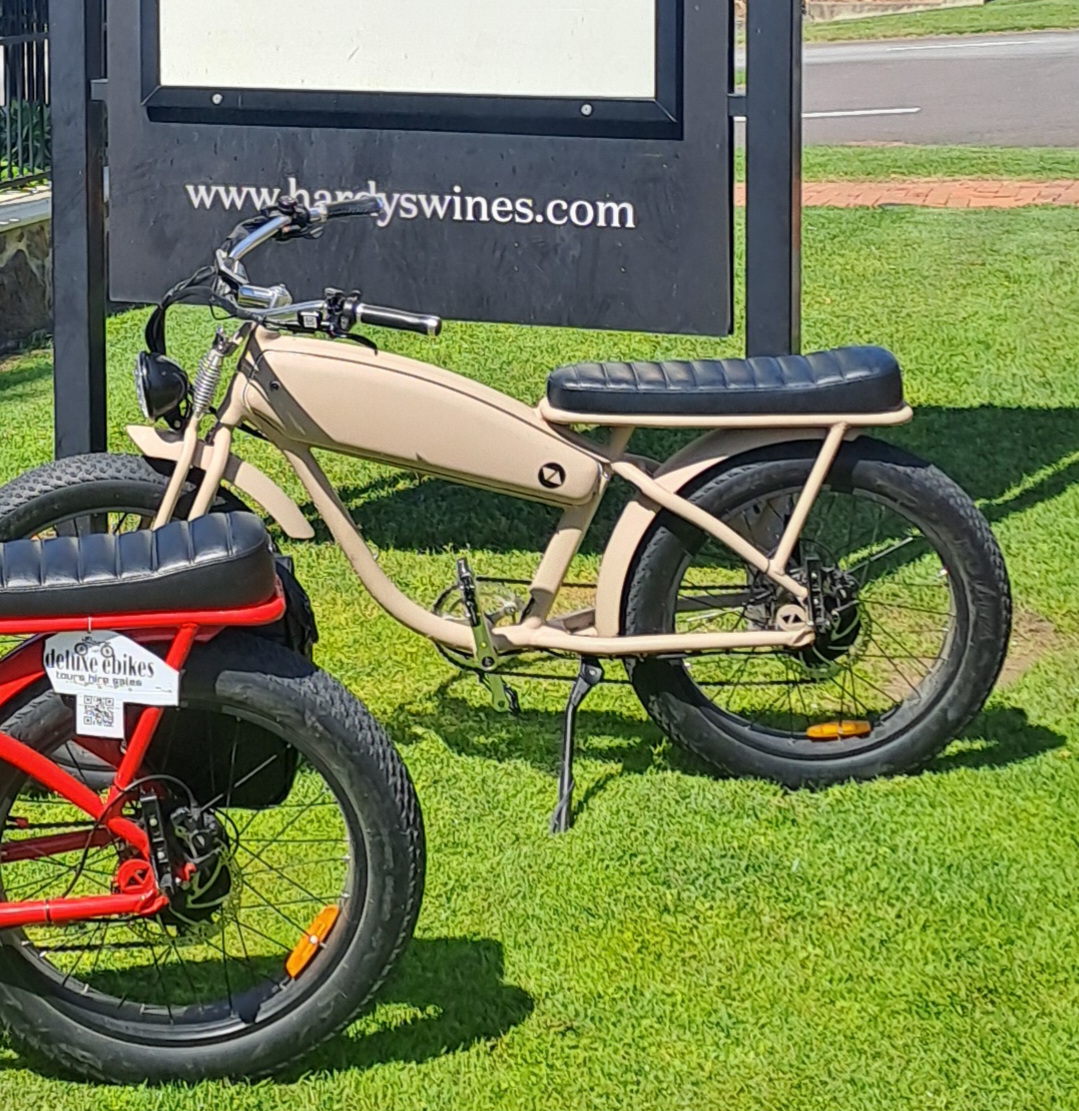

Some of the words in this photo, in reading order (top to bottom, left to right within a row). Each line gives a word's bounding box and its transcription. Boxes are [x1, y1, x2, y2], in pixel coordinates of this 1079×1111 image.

[185, 177, 636, 230] wwwhardyswines.com
[45, 648, 98, 673] deluxe
[101, 652, 155, 679] ebikes
[56, 671, 85, 682] tours
[88, 674, 109, 685] hire
